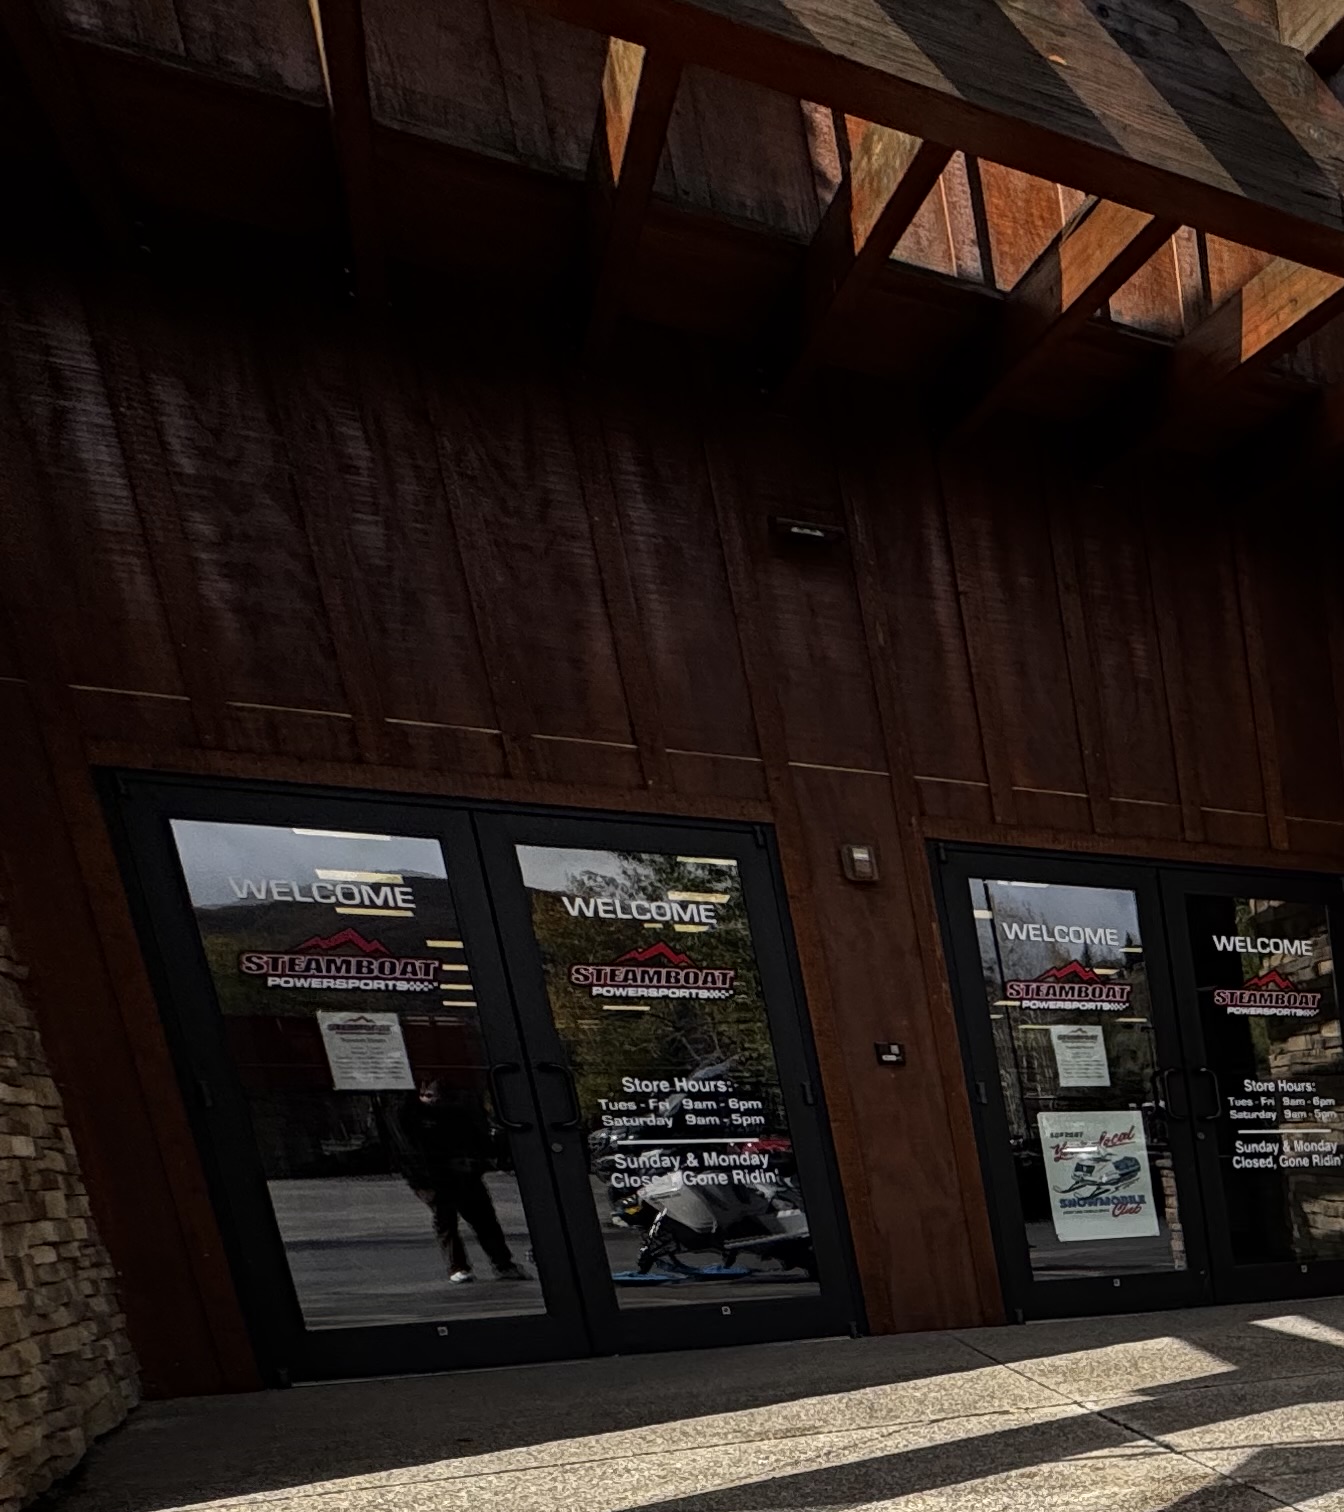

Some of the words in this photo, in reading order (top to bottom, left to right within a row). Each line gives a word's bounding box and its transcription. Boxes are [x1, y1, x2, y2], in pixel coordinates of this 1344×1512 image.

[228, 876, 416, 909] WELCOME
[561, 896, 718, 925] WELCOME
[1002, 922, 1119, 946] WELCOME
[1212, 935, 1314, 956] WELCOME
[241, 953, 440, 980] STEAMBOAT
[267, 976, 409, 991] POWERSPORTS
[571, 965, 735, 988] STEAMBOAT
[592, 986, 710, 999] POWERSPORTS
[1006, 981, 1131, 1001] STEAMBOAT
[1214, 989, 1321, 1008] STEAMBOAT
[1022, 1000, 1111, 1011] POWERSPORTS
[1227, 1006, 1305, 1017] POWERSPORTS
[621, 1076, 670, 1093] Store
[674, 1077, 733, 1093] Hours:
[1243, 1079, 1275, 1092] Store
[1278, 1080, 1316, 1092] Hours:
[597, 1099, 637, 1111] Tues
[648, 1099, 670, 1111] Fri
[681, 1099, 717, 1110] 9am
[728, 1099, 762, 1112] 6pm
[1227, 1096, 1253, 1106] Tues
[1260, 1096, 1275, 1106] Fri
[1282, 1096, 1305, 1106] 9am
[1312, 1096, 1335, 1107] 6pm
[602, 1114, 673, 1128] Saturday
[685, 1114, 719, 1126] 9am
[732, 1113, 765, 1127] 5pm
[1229, 1109, 1277, 1121] Saturday
[1284, 1109, 1307, 1119] 9am
[1314, 1109, 1337, 1122] 5pm
[1235, 1140, 1279, 1155] Sunday
[1282, 1140, 1291, 1152] &
[1294, 1140, 1338, 1153] Monday
[614, 1153, 680, 1171] Sunday
[686, 1152, 699, 1168] &
[703, 1152, 769, 1168] Monday
[1232, 1156, 1277, 1169] Closed,
[1279, 1156, 1309, 1167] Gone
[1312, 1154, 1344, 1167] Ridin'
[682, 1170, 728, 1186] Gone
[732, 1168, 779, 1185] Ridin'
